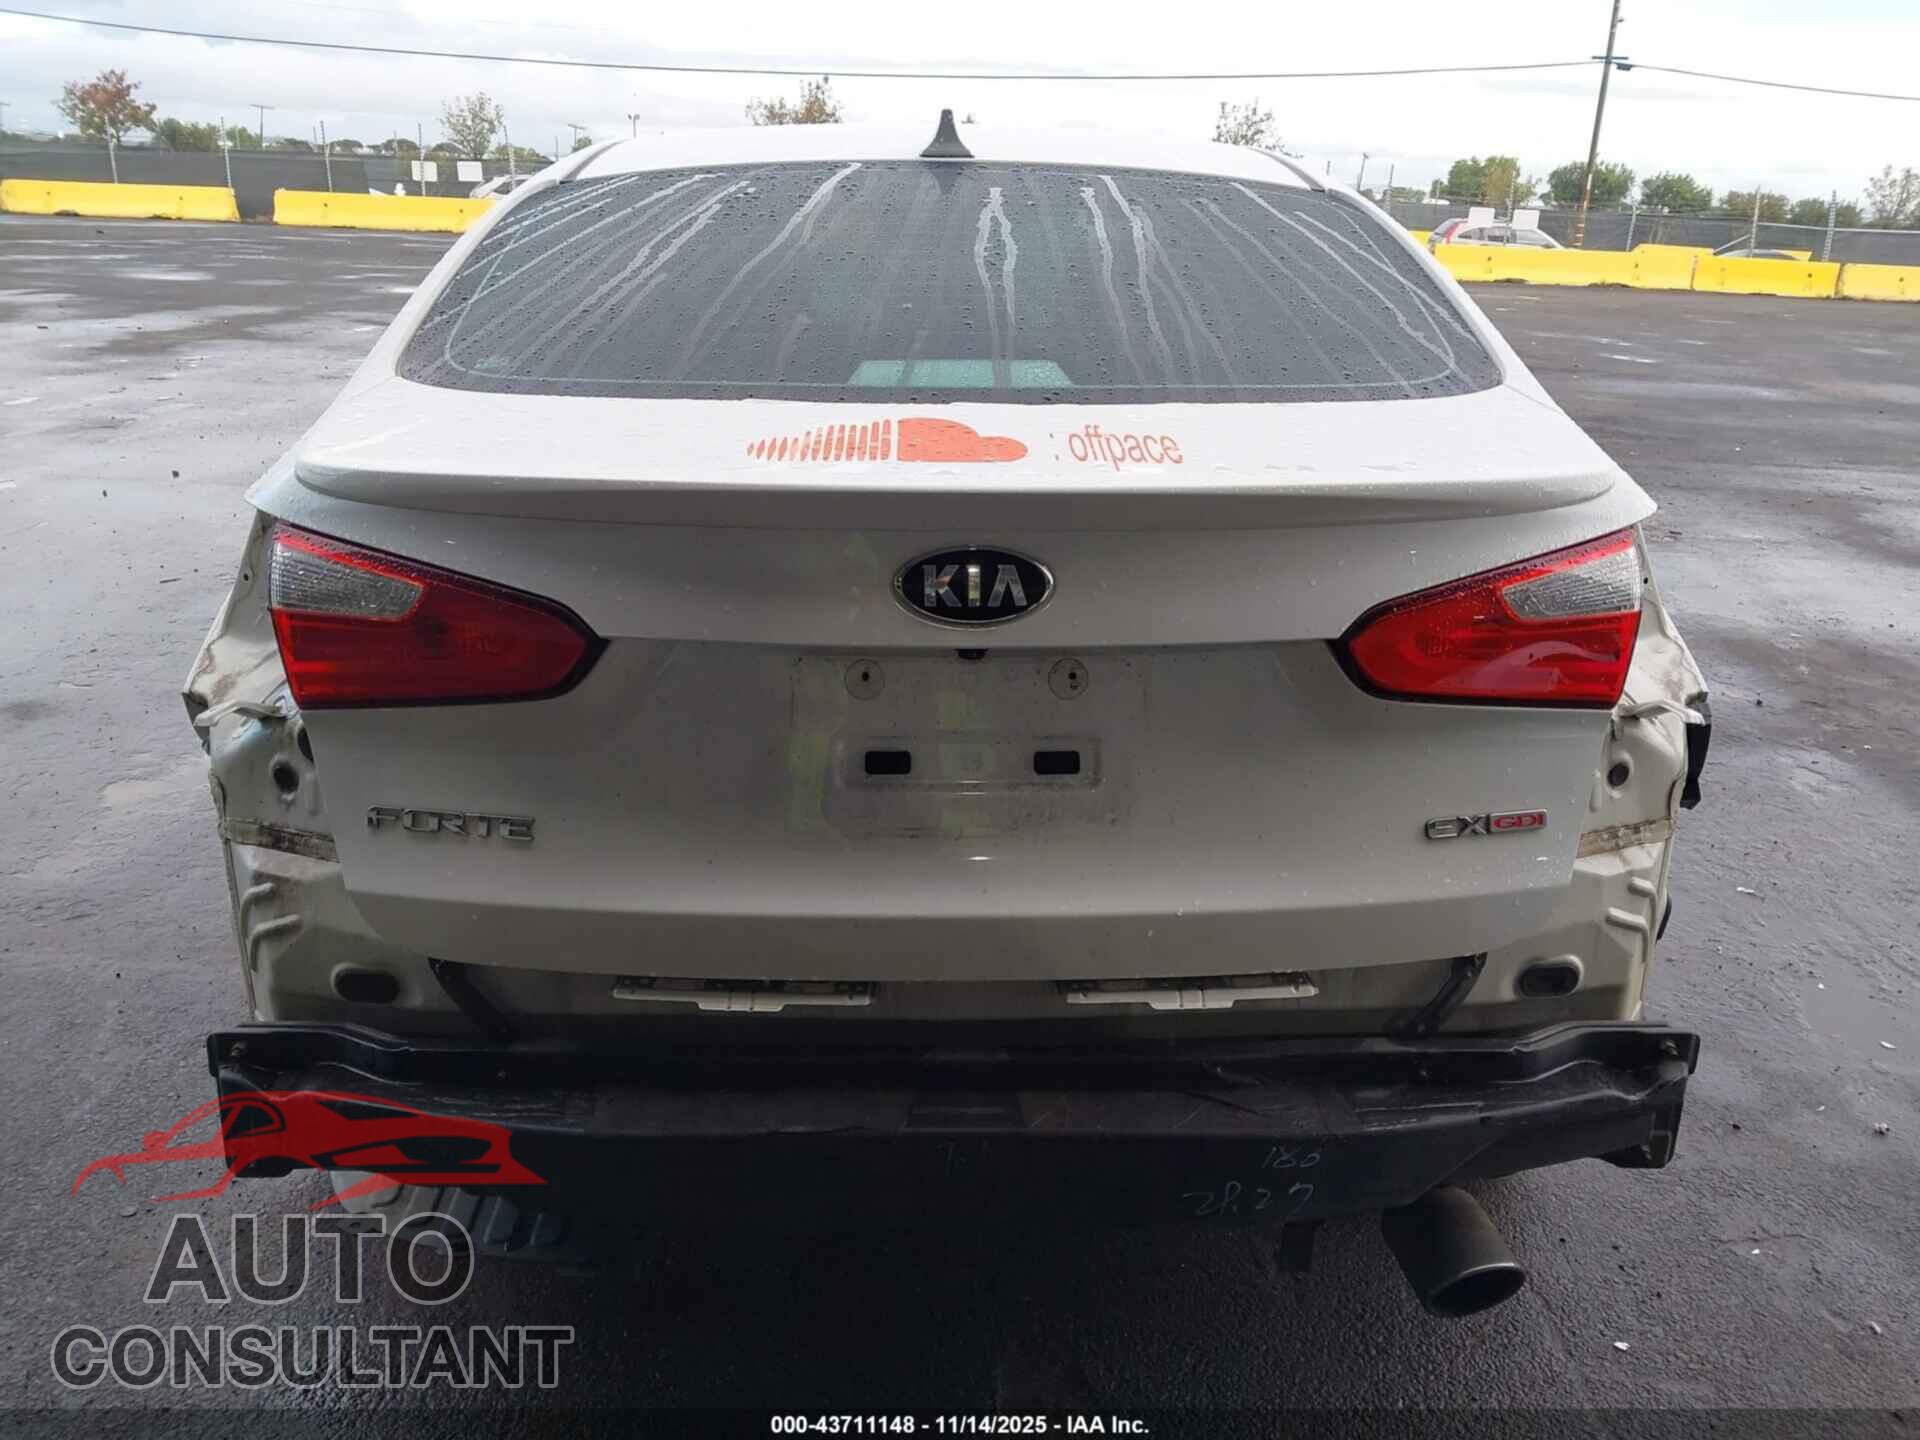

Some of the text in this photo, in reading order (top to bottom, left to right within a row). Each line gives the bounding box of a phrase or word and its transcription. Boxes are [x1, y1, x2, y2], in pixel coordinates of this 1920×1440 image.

[1067, 424, 1184, 472] offpace
[922, 563, 1029, 608] KIA
[367, 804, 536, 843] FORTE
